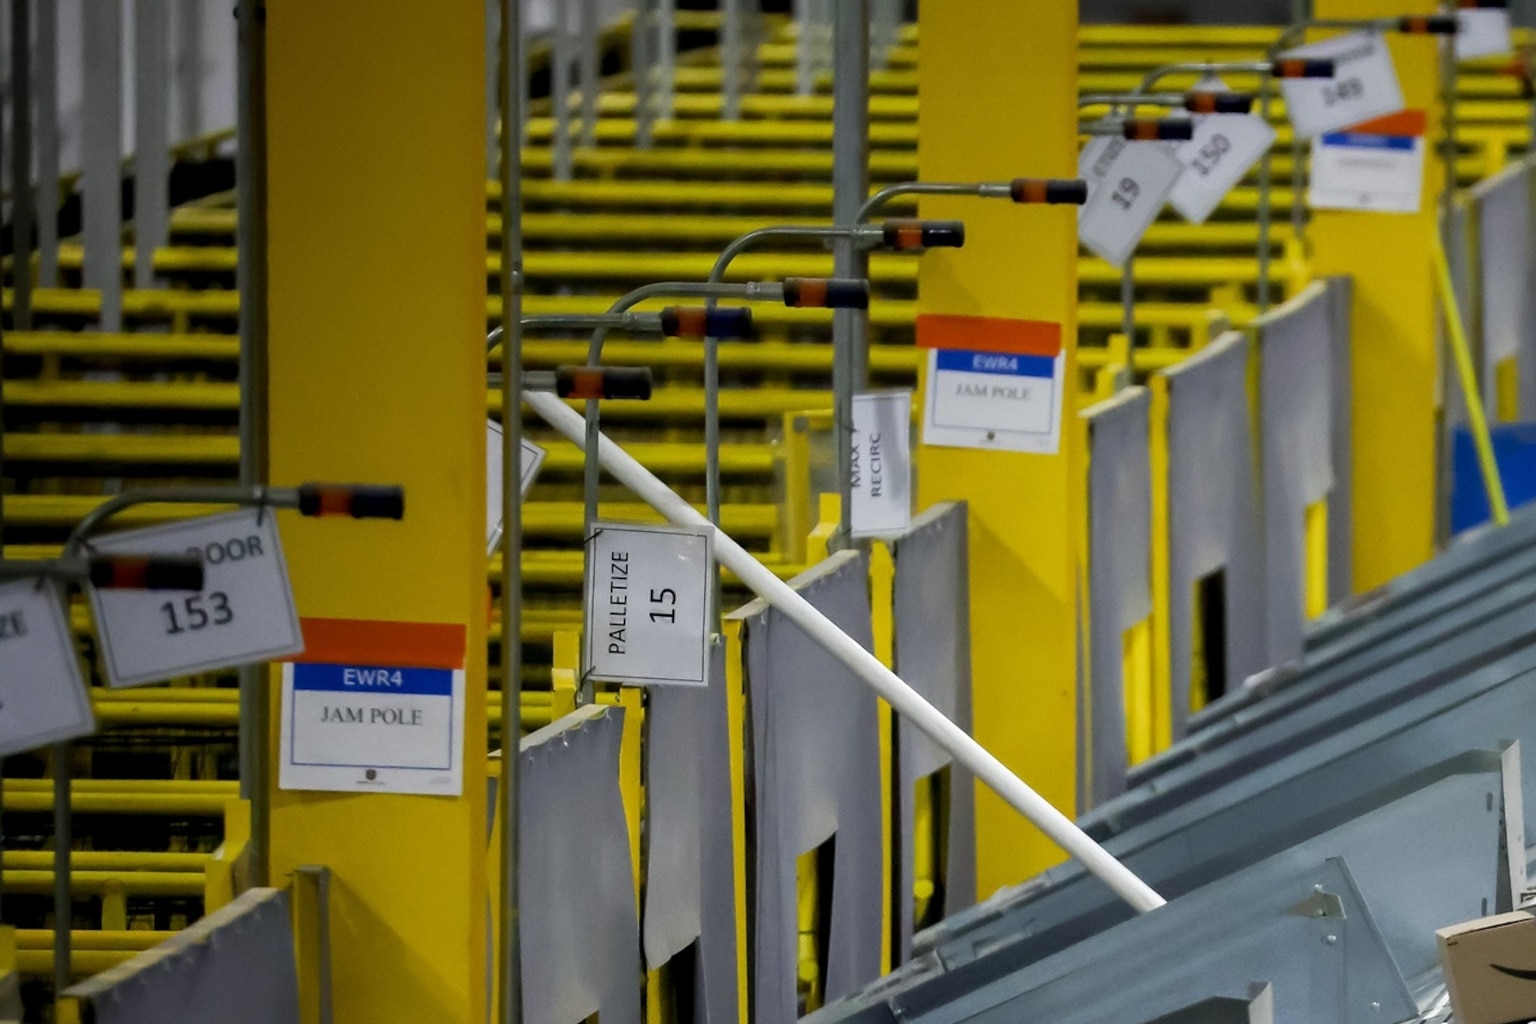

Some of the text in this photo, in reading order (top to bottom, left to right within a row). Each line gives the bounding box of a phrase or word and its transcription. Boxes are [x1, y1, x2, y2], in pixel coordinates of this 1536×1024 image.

[1191, 133, 1232, 176] 150
[1111, 177, 1141, 211] 19
[972, 354, 1018, 371] EWR4
[956, 382, 1032, 400] JAM POLE
[870, 432, 882, 497] RECIRC
[161, 591, 234, 635] 153
[608, 551, 629, 655] PALLETIZE
[650, 588, 676, 624] 15
[342, 668, 404, 687] EWR4
[320, 706, 424, 726] JAM POLE
